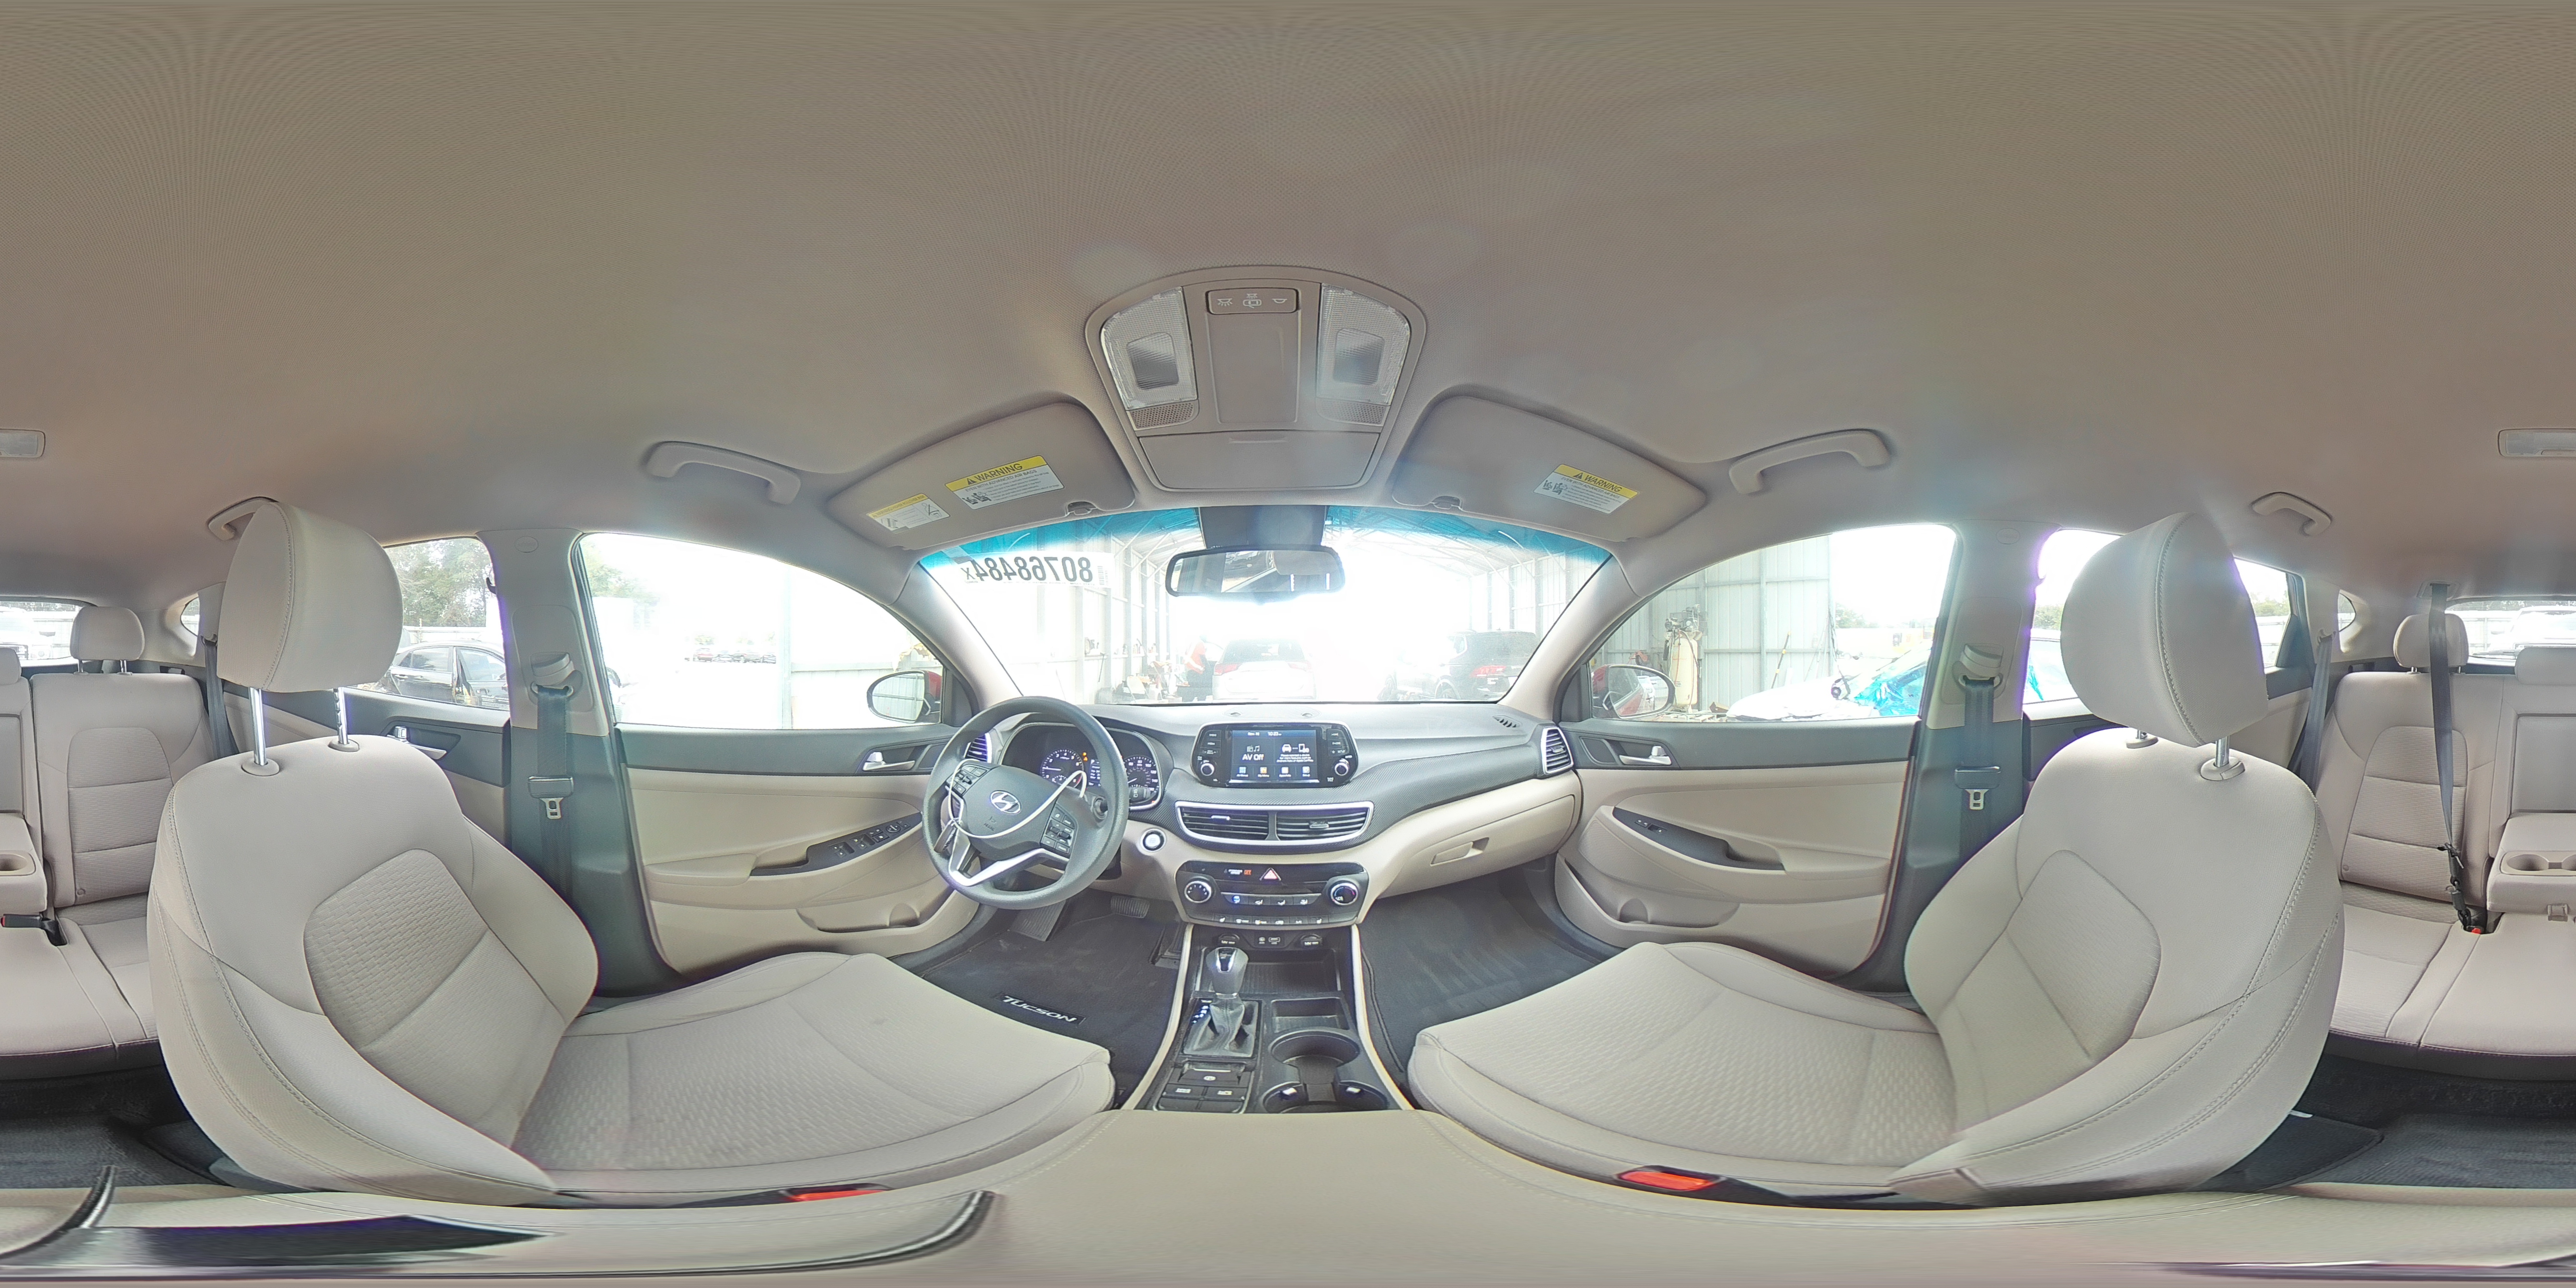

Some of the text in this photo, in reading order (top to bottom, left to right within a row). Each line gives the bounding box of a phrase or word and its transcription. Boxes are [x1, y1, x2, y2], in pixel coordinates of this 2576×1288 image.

[974, 463, 1023, 481] WARNING
[989, 475, 1014, 485] ADVANCED
[1584, 484, 1604, 494] ADVANCED
[1585, 475, 1622, 493] WARNING
[1003, 995, 1078, 1022] TUCSON
